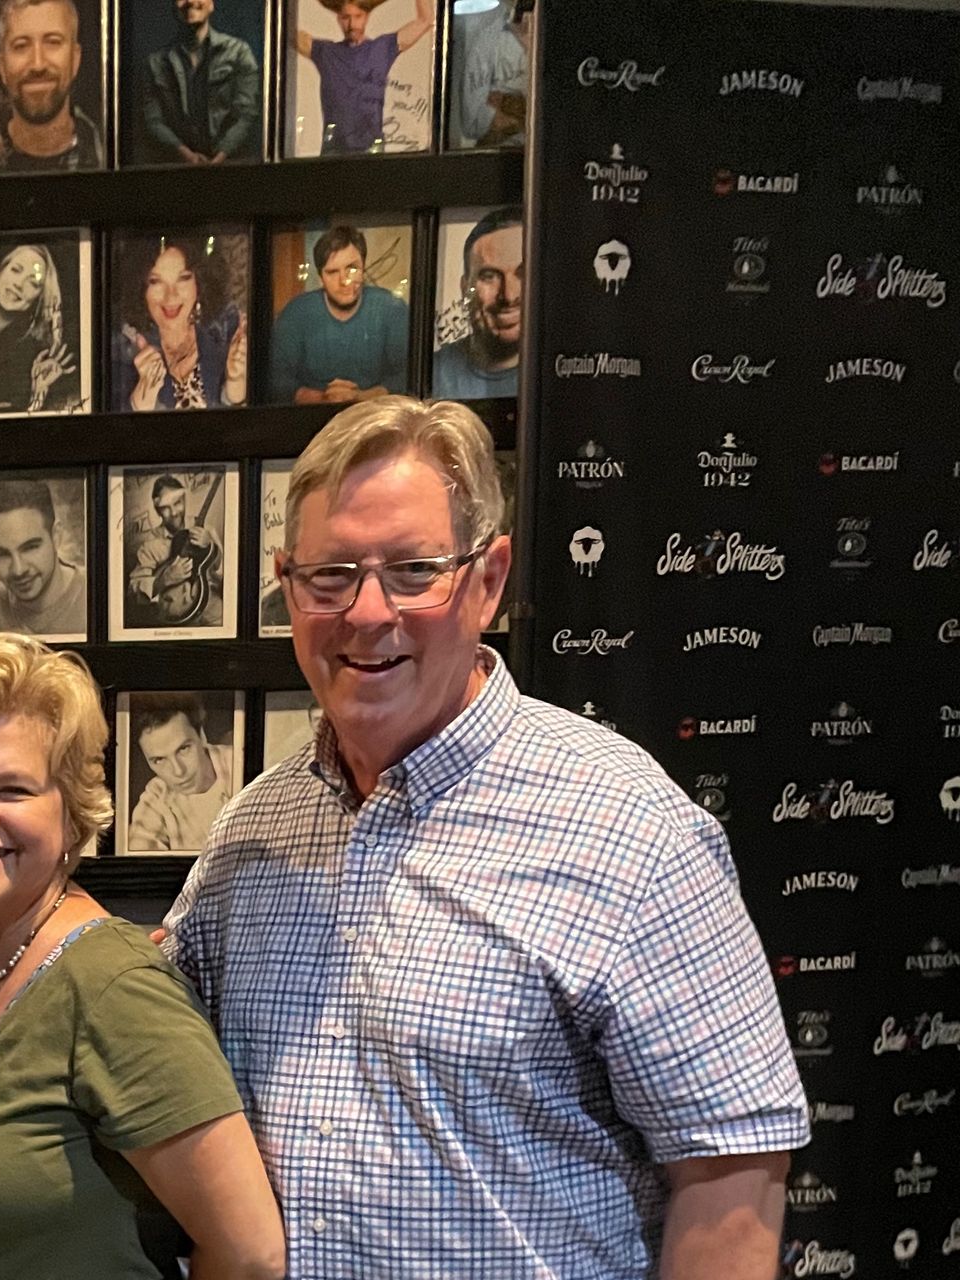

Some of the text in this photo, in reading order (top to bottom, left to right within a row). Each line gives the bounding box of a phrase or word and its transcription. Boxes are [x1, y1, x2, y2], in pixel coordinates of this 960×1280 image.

[719, 69, 805, 98] JAMESON
[592, 184, 640, 203] 1942
[738, 172, 800, 193] BACARDÍ
[816, 253, 946, 308] Side Splitters
[555, 353, 641, 378] Captain Morgan
[691, 354, 777, 384] Crown Royal
[825, 358, 907, 383] JAMESON
[558, 457, 625, 478] PATRÓN
[841, 451, 900, 471] BACARDÍ
[703, 472, 752, 487] 1942
[657, 532, 786, 581] Side Splitters
[913, 529, 952, 571] Side
[552, 629, 635, 655] Crown Royal
[683, 626, 762, 652] JAMESON
[700, 714, 758, 735] BACARDÍ
[773, 782, 811, 823] Side
[782, 871, 860, 896] JAMESON
[799, 951, 857, 972] BACARDÍ
